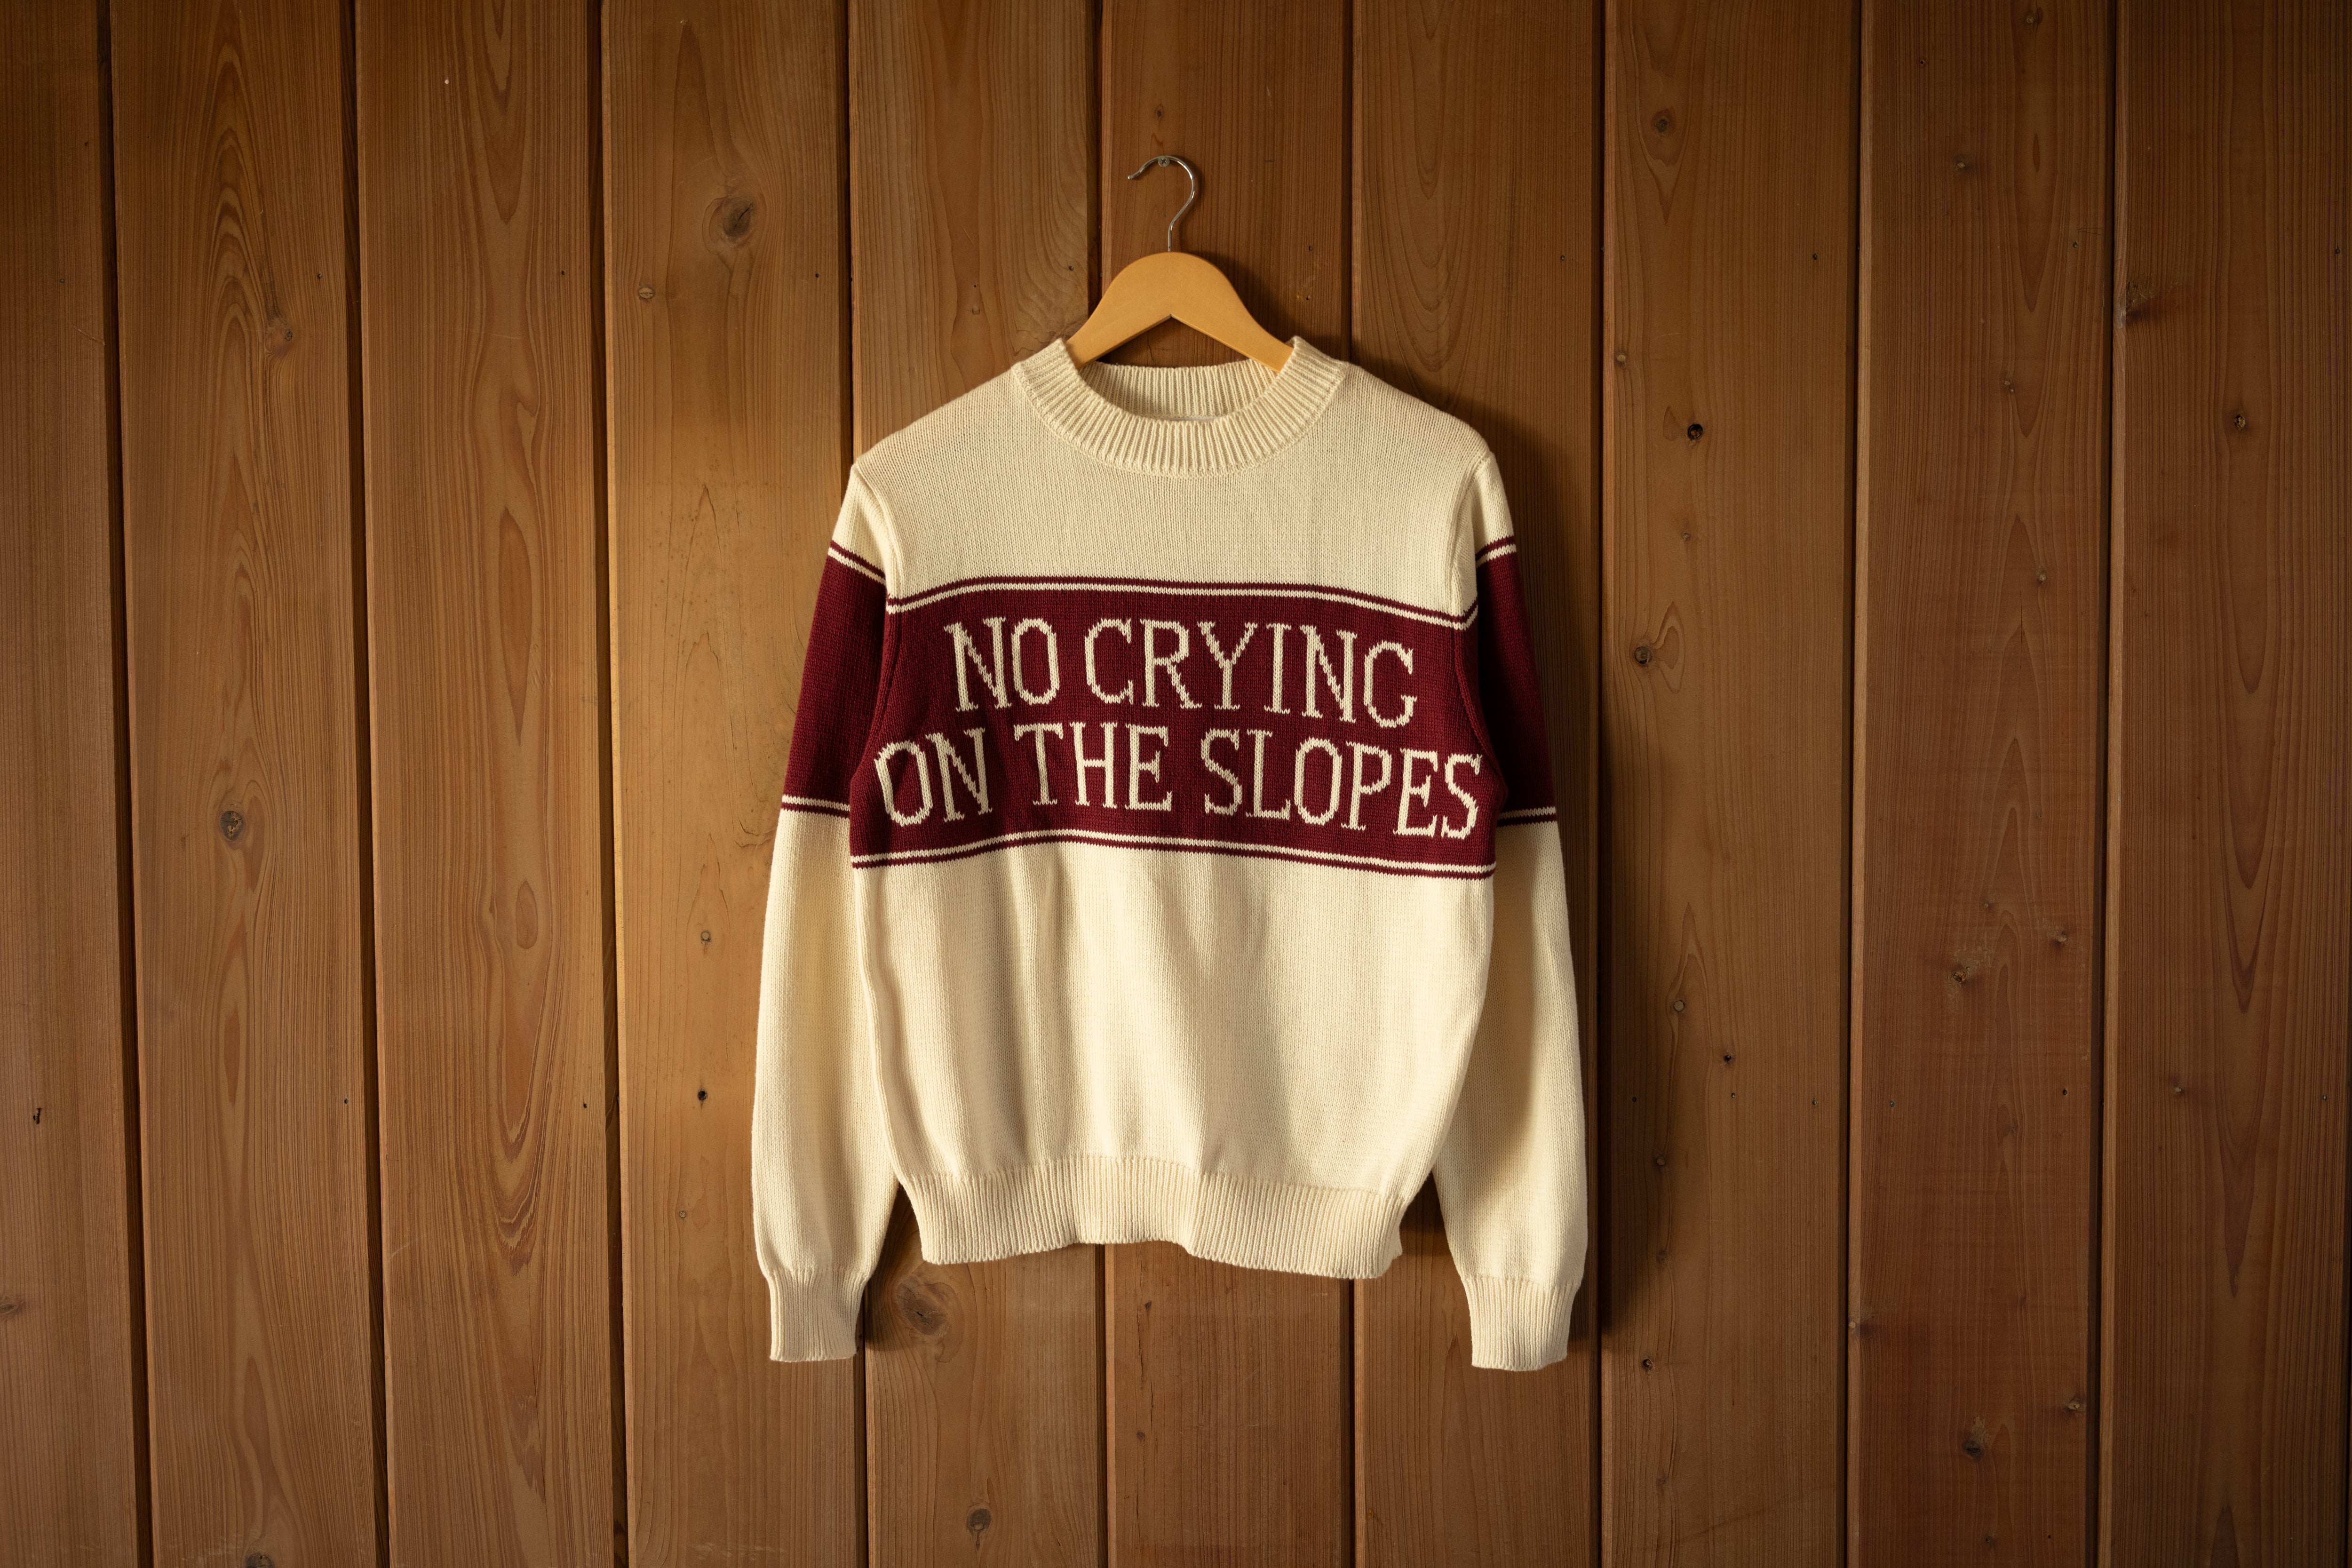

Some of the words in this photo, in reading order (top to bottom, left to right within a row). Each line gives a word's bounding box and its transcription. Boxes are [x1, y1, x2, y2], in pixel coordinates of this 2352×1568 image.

[944, 617, 1060, 712] NO
[1084, 618, 1417, 728] CRYING
[874, 728, 993, 827] ON
[1013, 722, 1172, 812] THE
[1201, 728, 1483, 840] SLOPES
